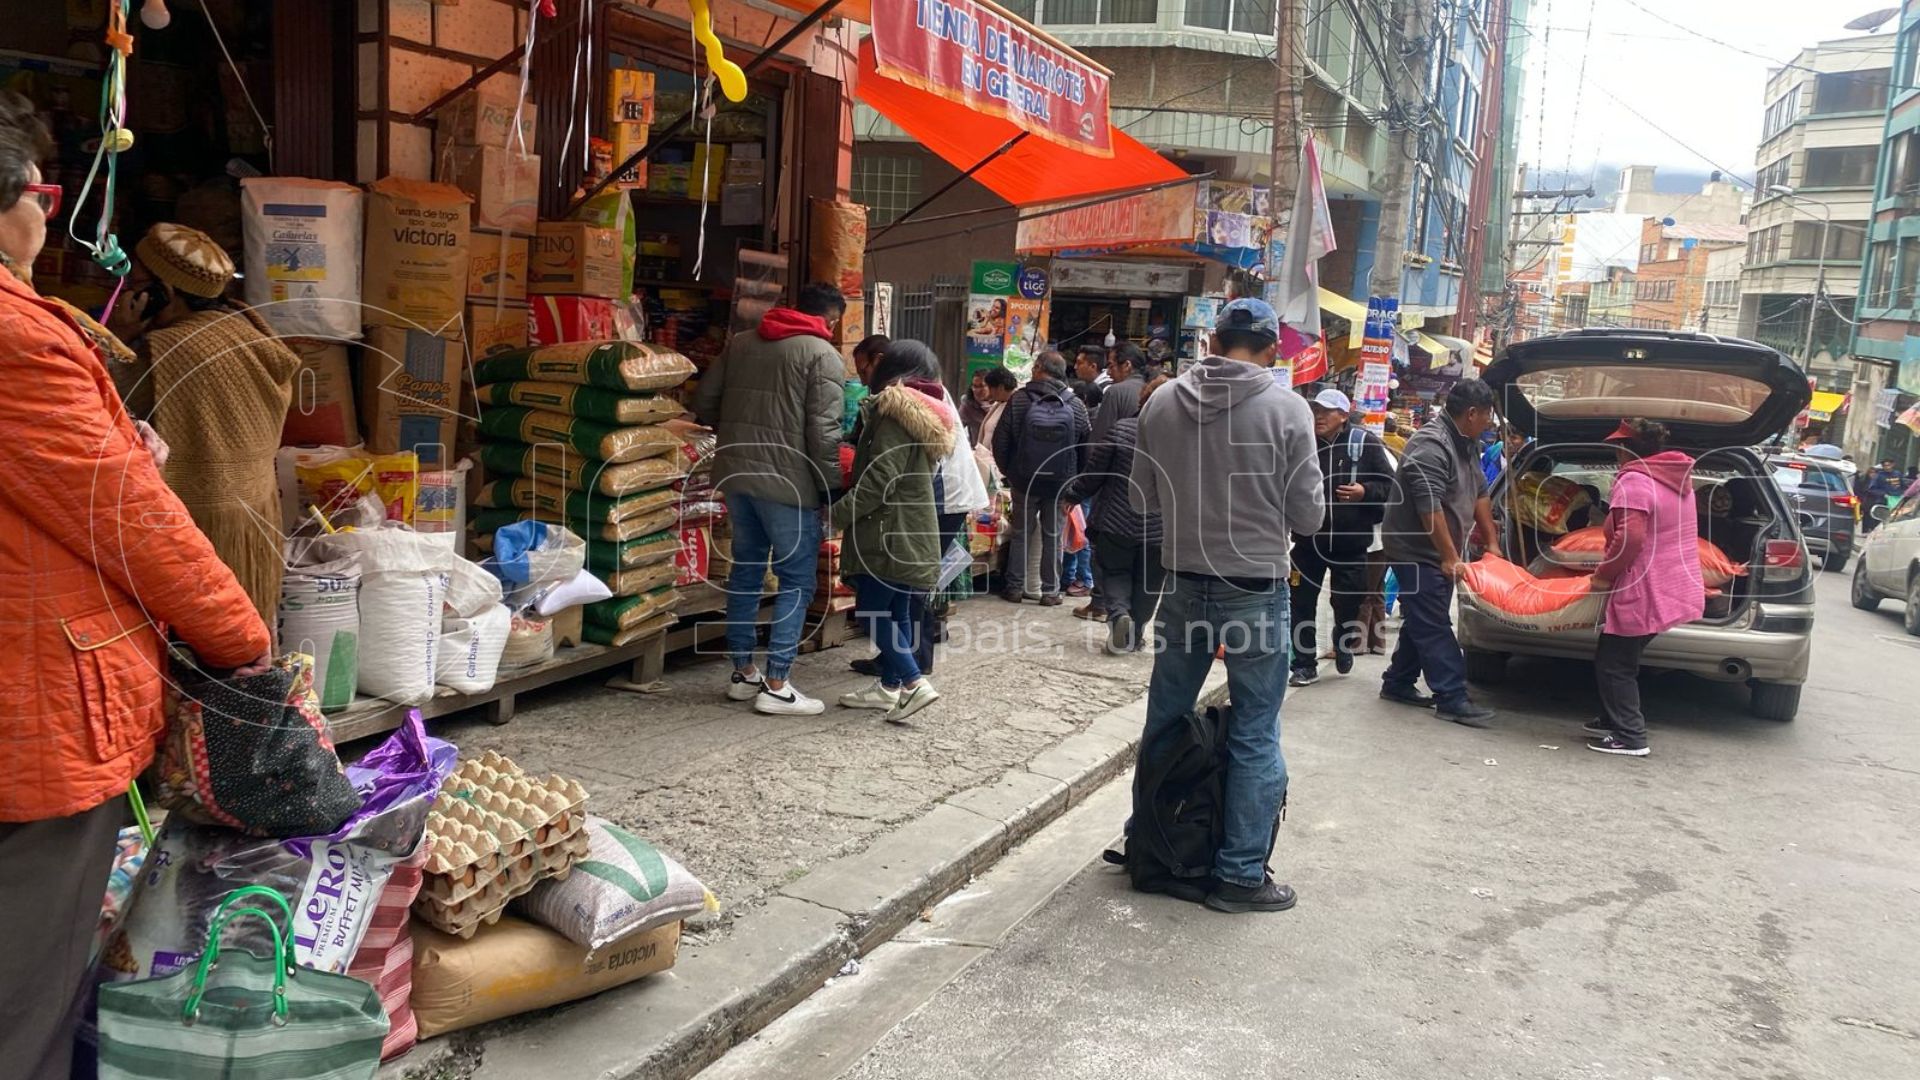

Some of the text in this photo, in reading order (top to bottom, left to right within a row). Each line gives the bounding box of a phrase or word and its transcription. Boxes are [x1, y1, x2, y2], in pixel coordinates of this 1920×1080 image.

[962, 53, 1050, 122] EN GEERAL
[422, 208, 437, 218] de
[393, 227, 457, 247] victoria
[1023, 279, 1045, 295] tigo
[466, 630, 480, 679] Garbanzo
[316, 905, 338, 958] PREMIUM
[332, 891, 358, 948] BUFFET
[607, 942, 656, 971] victoria
